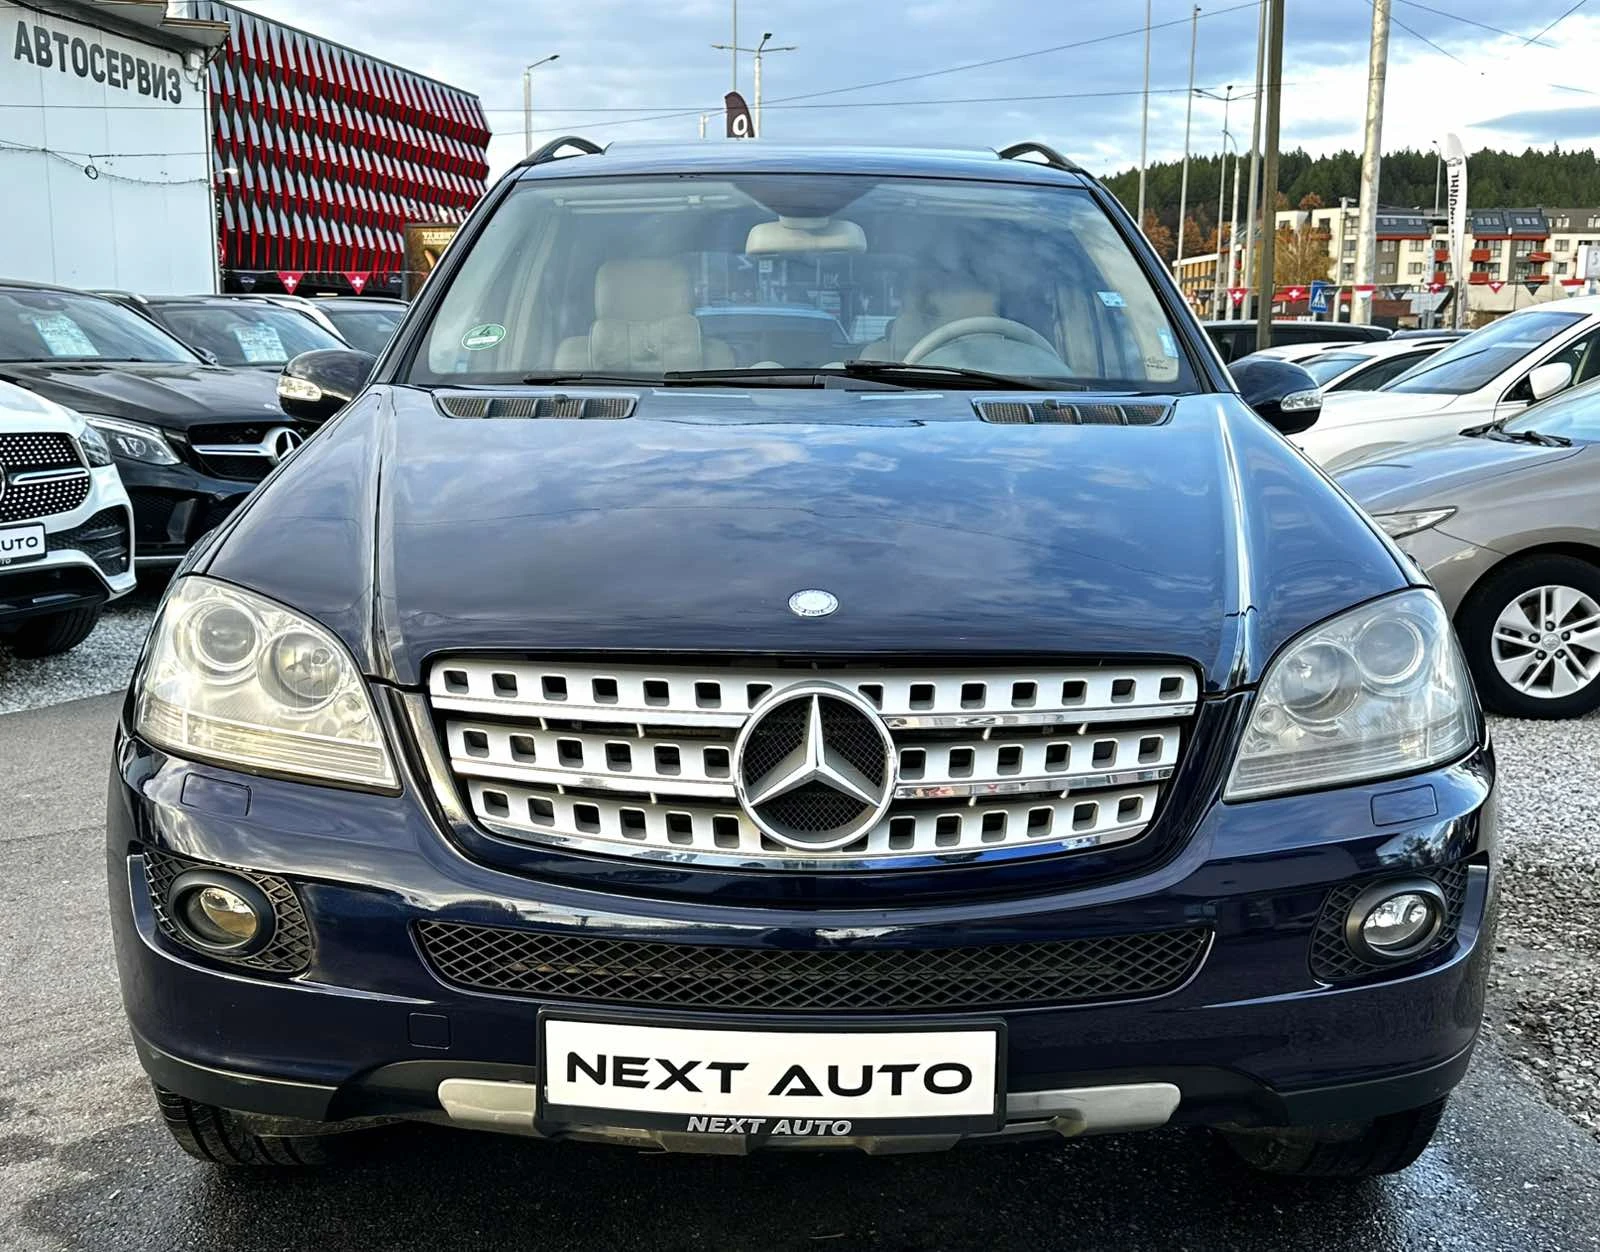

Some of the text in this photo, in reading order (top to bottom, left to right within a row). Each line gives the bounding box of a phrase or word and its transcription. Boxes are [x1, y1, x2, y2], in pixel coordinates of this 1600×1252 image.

[14, 21, 182, 104] АВТОСЕРВИЗ
[0, 536, 38, 551] UTO
[567, 1051, 973, 1097] NEXT AUTO
[686, 1116, 852, 1136] NEXT AUTO
